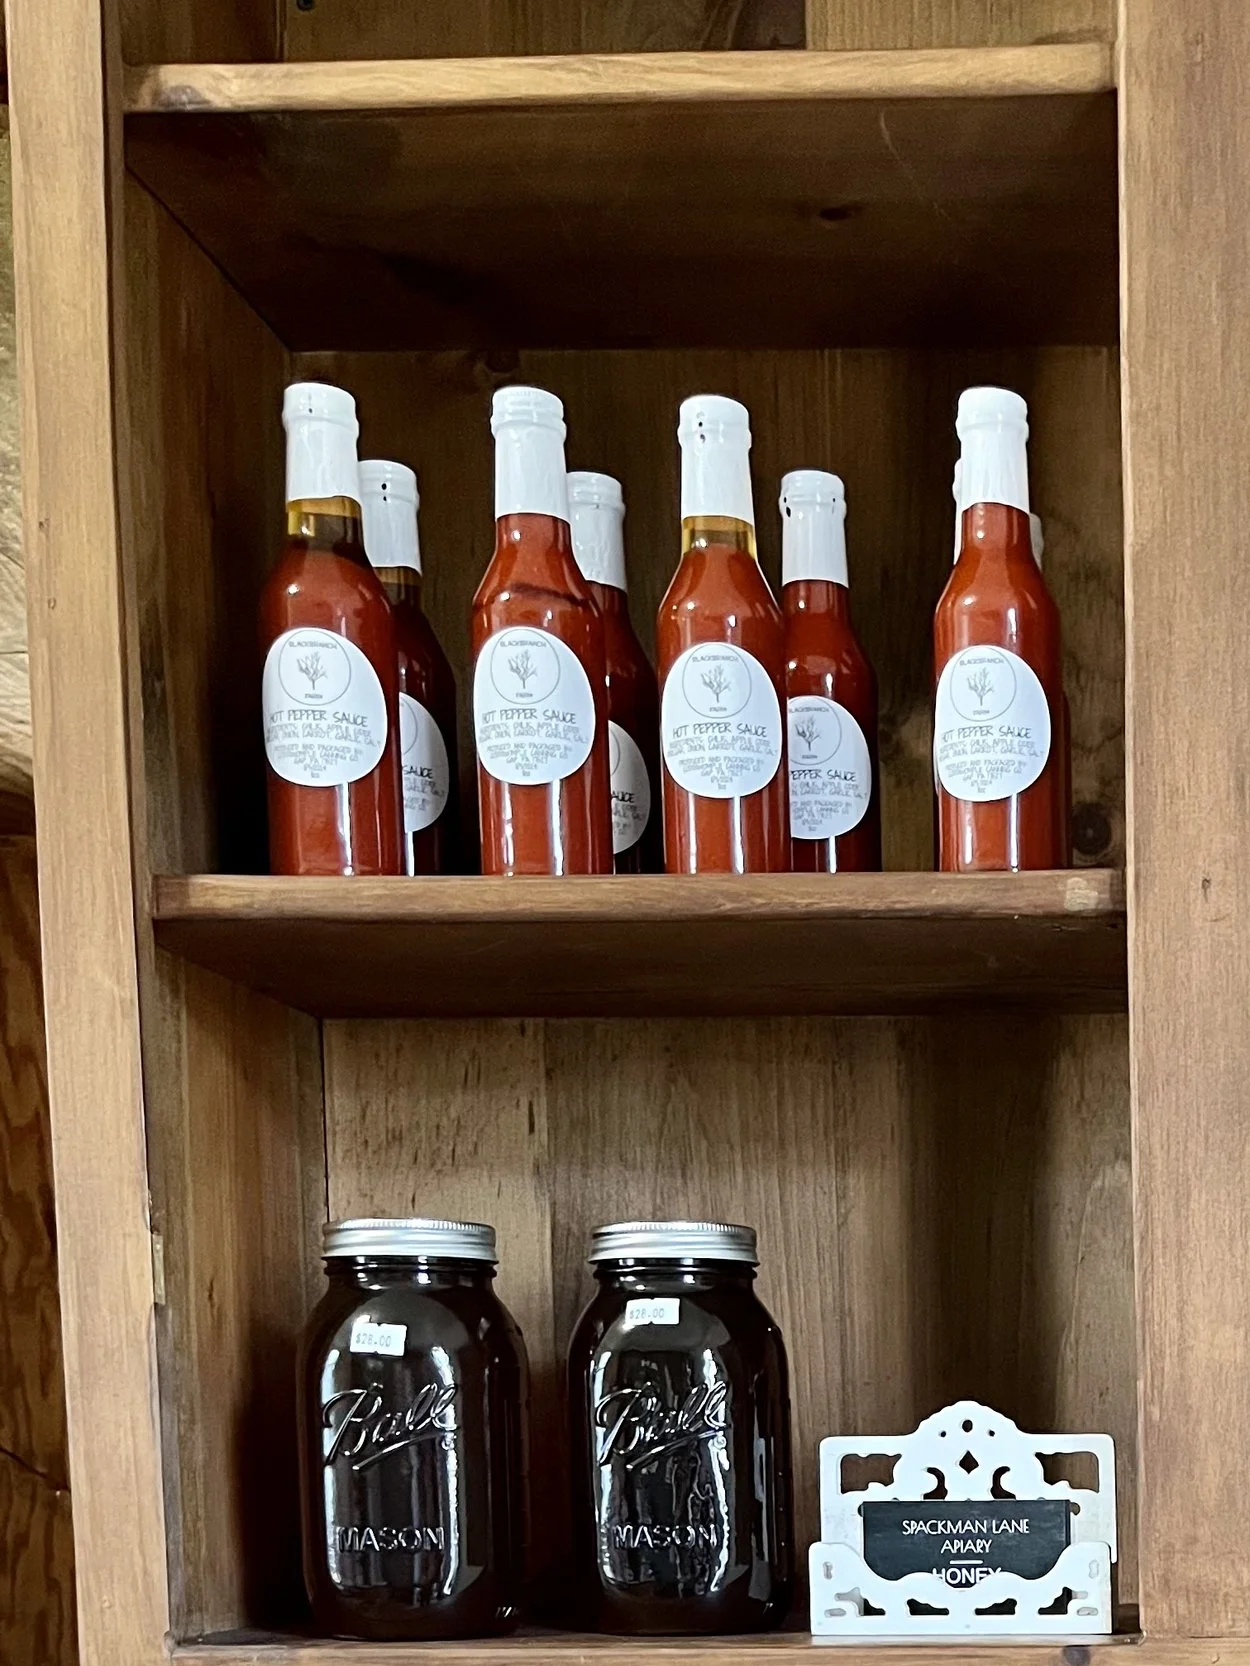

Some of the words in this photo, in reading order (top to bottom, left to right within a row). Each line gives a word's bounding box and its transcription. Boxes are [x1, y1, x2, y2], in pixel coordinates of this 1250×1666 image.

[288, 709, 327, 721] PEPPER
[332, 711, 368, 728] SAUCE
[500, 708, 537, 721] PEPPER
[542, 709, 577, 725] SAUCE
[672, 725, 690, 739] HOT
[693, 722, 731, 735] PEPPER
[736, 723, 767, 738] SAUCE
[957, 725, 994, 739] PEPPER
[998, 725, 1032, 739] SAUCE
[827, 769, 857, 782] SAUCE
[629, 1307, 665, 1320] $28.00
[355, 1332, 391, 1348] $28.00
[902, 1519, 987, 1535] SPACKMAN
[991, 1519, 1030, 1535] LANE
[335, 1526, 445, 1551] MASON
[612, 1525, 717, 1548] MASON
[941, 1539, 992, 1554] APIARY
